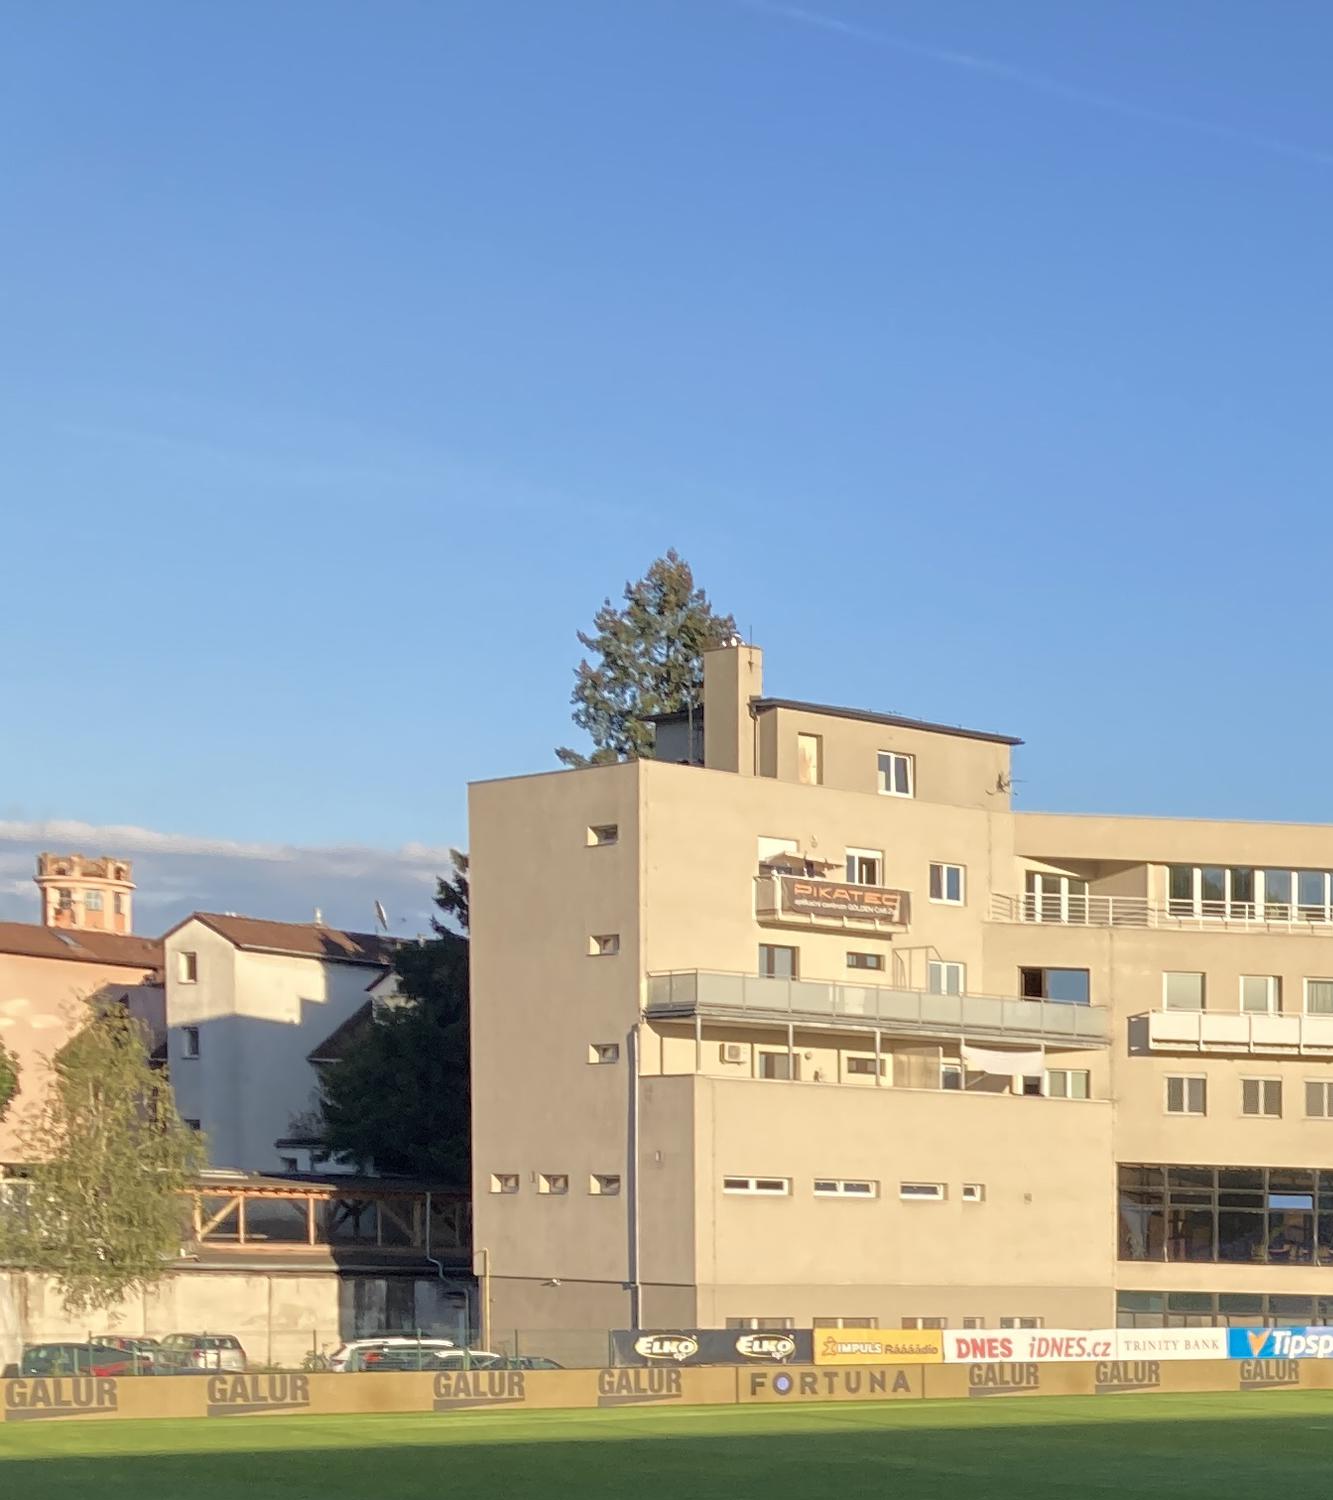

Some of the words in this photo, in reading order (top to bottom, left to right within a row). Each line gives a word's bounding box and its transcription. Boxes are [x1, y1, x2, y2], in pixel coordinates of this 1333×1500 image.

[794, 884, 901, 906] PIKATEC
[638, 1337, 695, 1353] ELKO
[738, 1336, 790, 1352] ELKO
[837, 1343, 882, 1353] IMPULS
[955, 1338, 1013, 1359] DNES
[1028, 1336, 1111, 1358] iDNES.cz
[1125, 1340, 1179, 1351] TRINITY
[1184, 1339, 1220, 1350] BANK
[969, 1362, 1040, 1386] GALUR
[1095, 1361, 1160, 1384] GALUR
[1240, 1359, 1299, 1381] GALUR
[5, 1377, 117, 1408] GALUR
[208, 1374, 309, 1403] GALUR
[433, 1370, 525, 1399] GALUR
[598, 1368, 682, 1396] GALUR
[751, 1370, 911, 1396] FORTUNA
